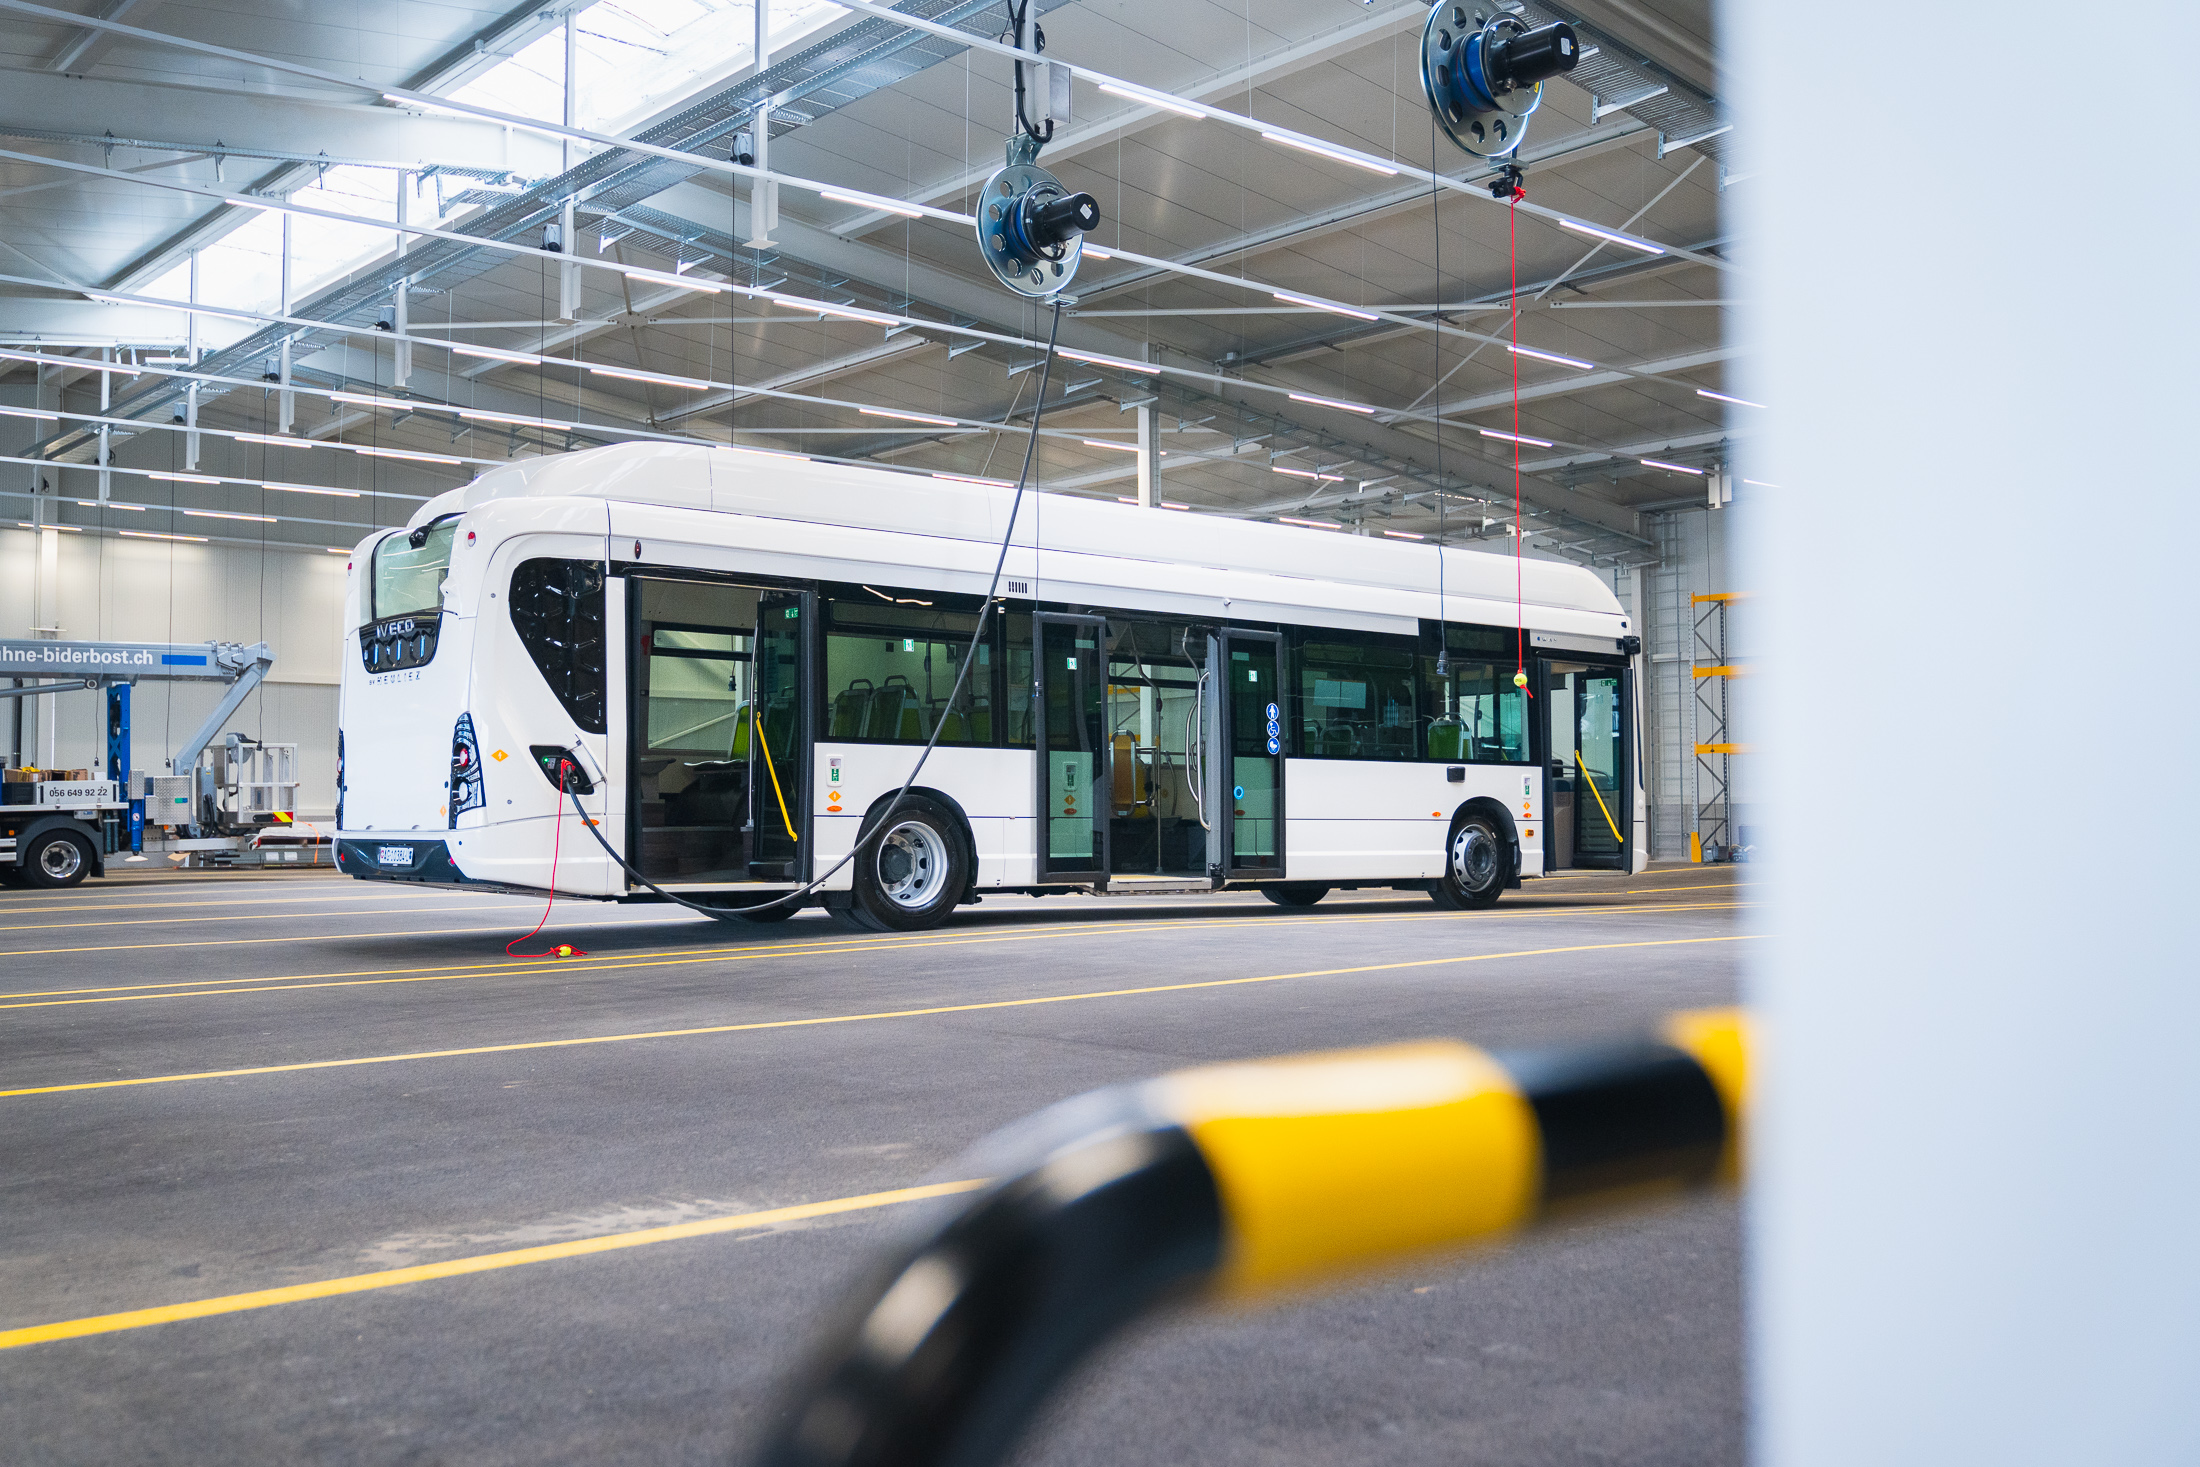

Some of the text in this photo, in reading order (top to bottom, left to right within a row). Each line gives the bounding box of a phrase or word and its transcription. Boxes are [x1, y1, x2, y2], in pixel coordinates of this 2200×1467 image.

[376, 619, 414, 638] IVECO
[0, 646, 153, 664] hne-biderbost.ch
[50, 789, 65, 797] 056
[97, 788, 108, 796] 22
